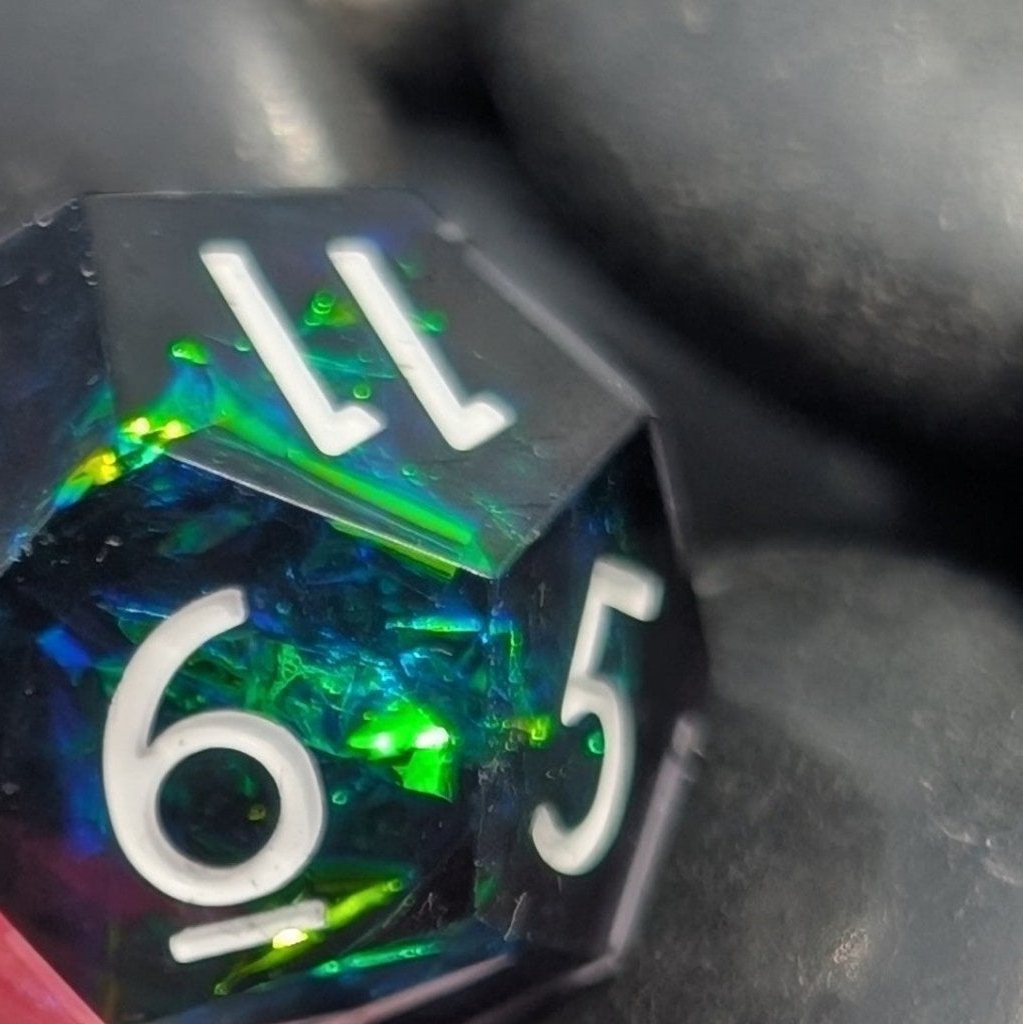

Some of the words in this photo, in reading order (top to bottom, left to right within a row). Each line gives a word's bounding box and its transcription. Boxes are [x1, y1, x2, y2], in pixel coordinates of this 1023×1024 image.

[201, 238, 513, 453] 11
[102, 587, 326, 906] 6
[531, 557, 664, 875] 5
